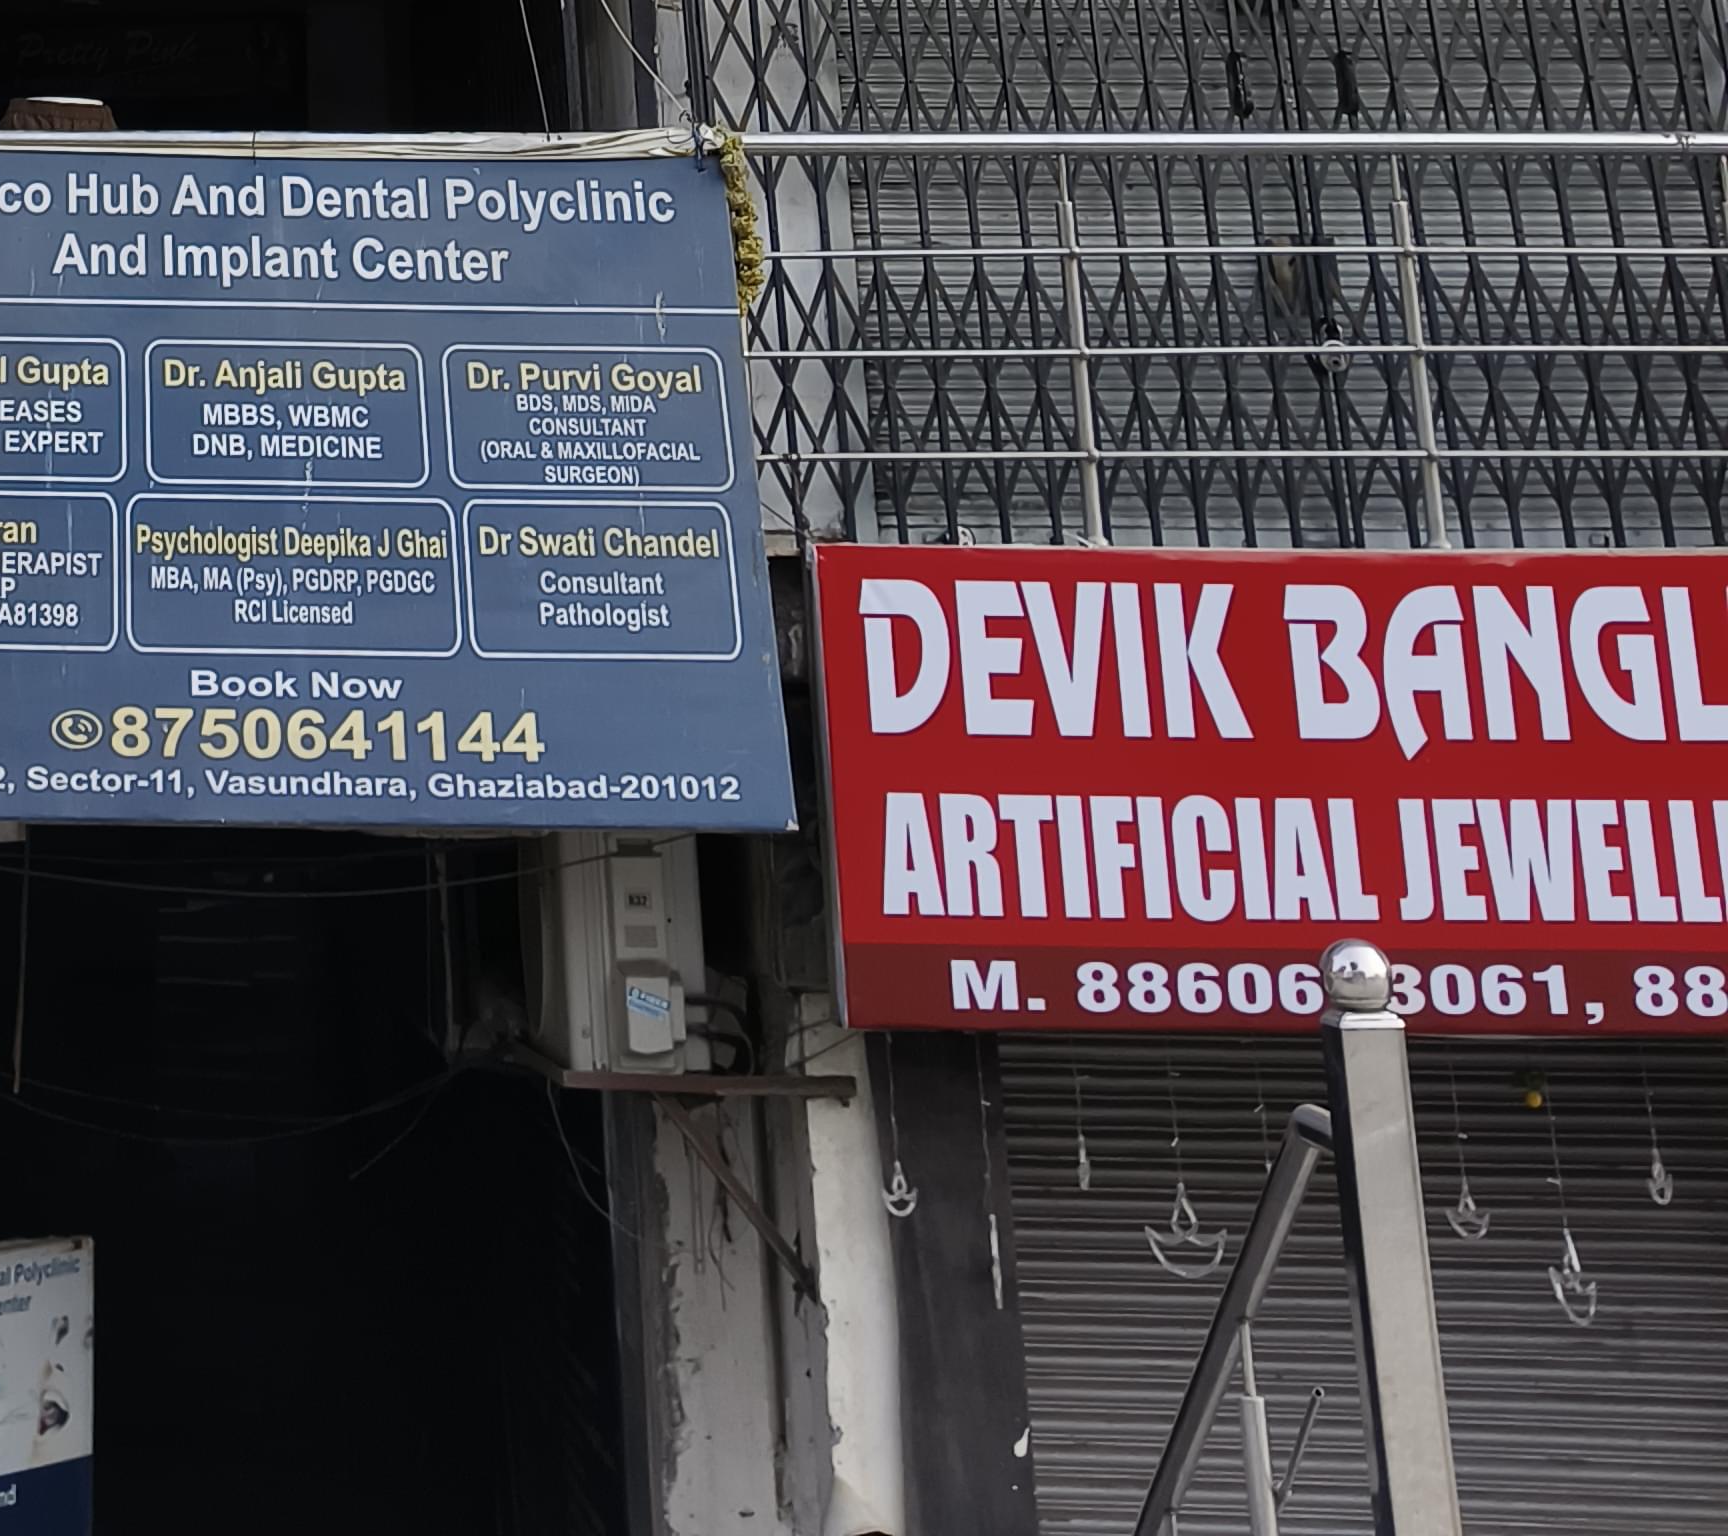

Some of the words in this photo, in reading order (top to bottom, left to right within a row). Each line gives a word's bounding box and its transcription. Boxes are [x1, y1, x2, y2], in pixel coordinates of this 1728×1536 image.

[67, 173, 160, 217] Hub
[171, 175, 265, 219] And
[282, 177, 429, 222] Dental
[444, 177, 676, 233] Polyclinic
[17, 357, 109, 392] Gupta
[164, 359, 206, 387] Dr.
[215, 360, 301, 395] Anjali
[312, 361, 406, 396] Gupta
[529, 418, 647, 437] CONSULTANT
[544, 465, 639, 487] SURGEON)
[539, 571, 664, 595] Consultant
[539, 601, 670, 631] Pathologist
[859, 578, 1256, 741] DEVIK
[111, 706, 546, 764] 8750641144
